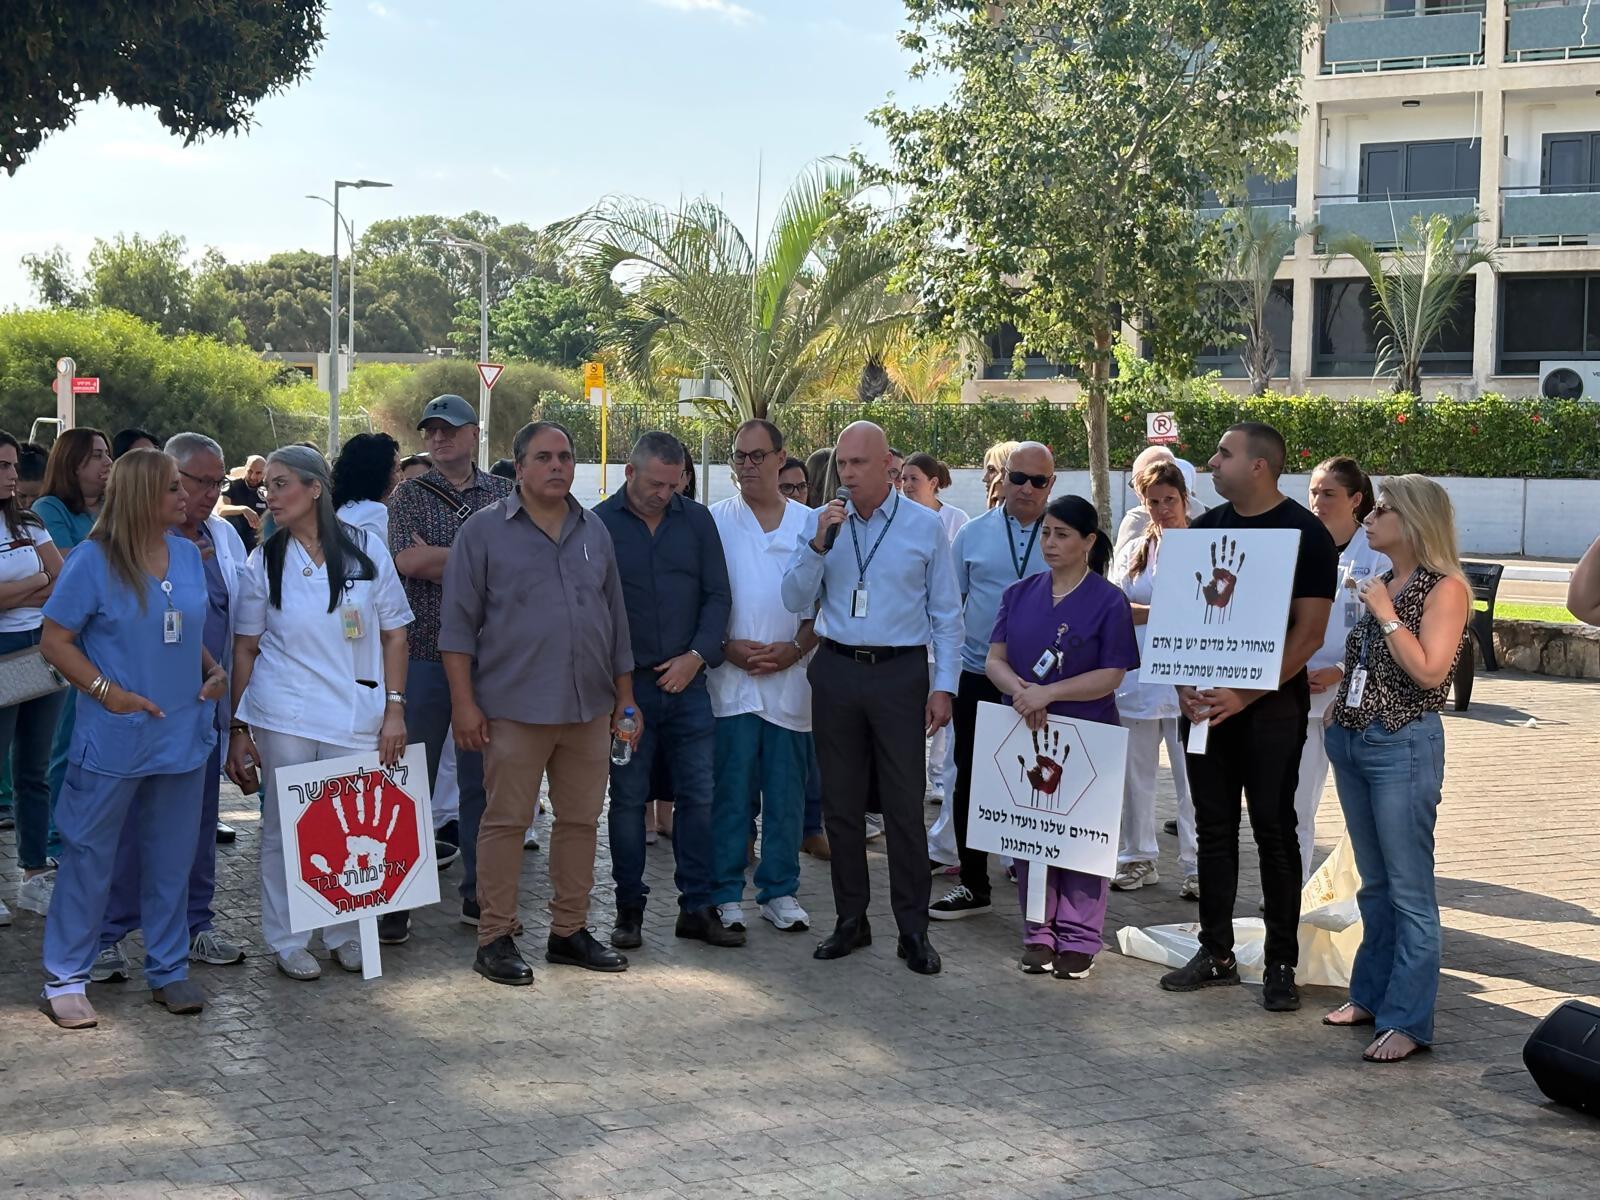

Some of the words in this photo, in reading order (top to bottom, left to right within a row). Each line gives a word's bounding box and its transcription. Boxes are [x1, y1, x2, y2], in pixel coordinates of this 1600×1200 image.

[1152, 636, 1171, 649] אדם
[1173, 636, 1183, 652] בן
[1185, 637, 1198, 650] יש
[1200, 638, 1224, 651] מדים
[1227, 636, 1238, 651] כל
[1240, 639, 1275, 653] מאחורי
[1151, 662, 1171, 675] בבית
[1173, 661, 1182, 675] לו
[1182, 663, 1214, 678] שמחכה
[1215, 664, 1248, 679] משפחה
[1250, 666, 1263, 680] עם
[381, 761, 409, 788] לא
[288, 766, 372, 804] לאפשר
[978, 804, 1008, 823] לטפל
[1010, 813, 1037, 830] נועדו
[1040, 818, 1066, 835] שלנו
[1069, 825, 1109, 844] הידיים
[1000, 836, 1042, 855] להתגונן
[1044, 845, 1060, 859] לא
[344, 858, 407, 886] אלימות
[310, 872, 341, 892] נגד
[335, 889, 389, 915] אחיות
